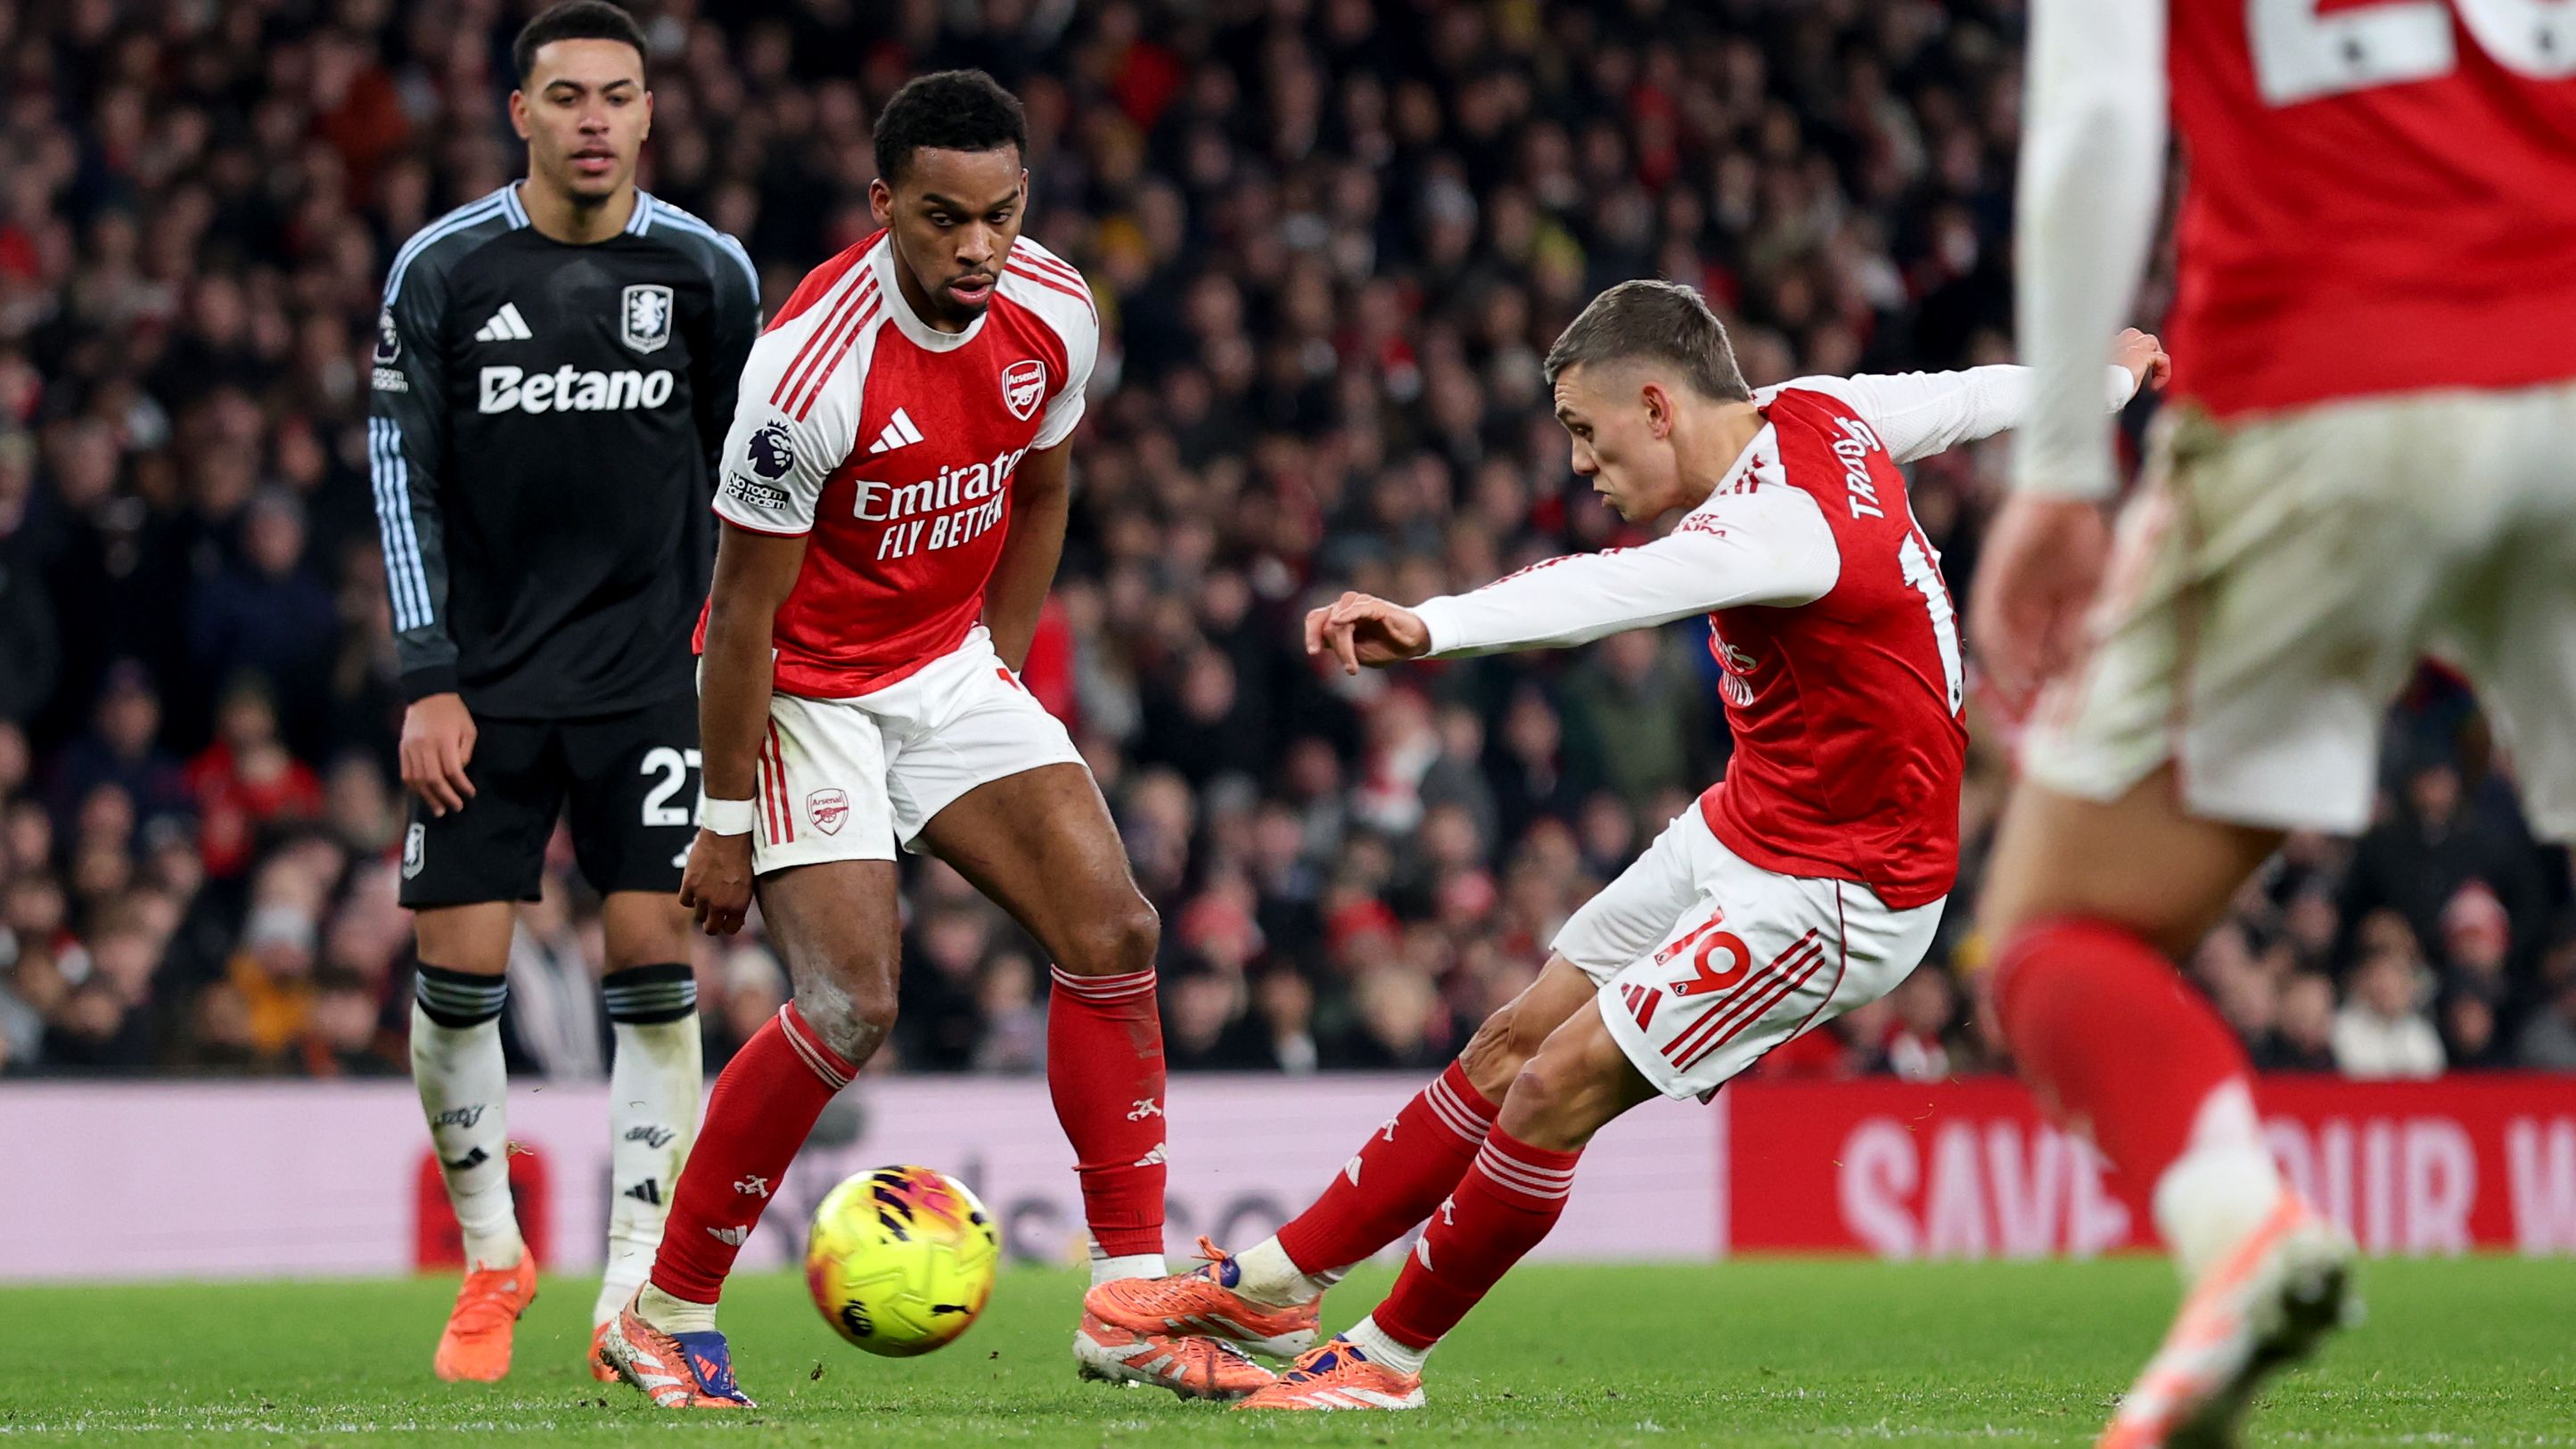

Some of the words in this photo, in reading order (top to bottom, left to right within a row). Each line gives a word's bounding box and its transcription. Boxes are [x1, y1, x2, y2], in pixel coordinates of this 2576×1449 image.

[478, 364, 674, 414] Betano
[1008, 368, 1040, 385] Arsenal
[726, 482, 743, 498] for
[742, 492, 786, 510] racism
[728, 471, 746, 489] No
[746, 483, 783, 500] room
[853, 445, 1029, 522] Emirate
[876, 519, 926, 561] FLY
[927, 486, 1006, 551] BETTER
[812, 796, 842, 806] Arsenal
[1653, 905, 1752, 997] 19
